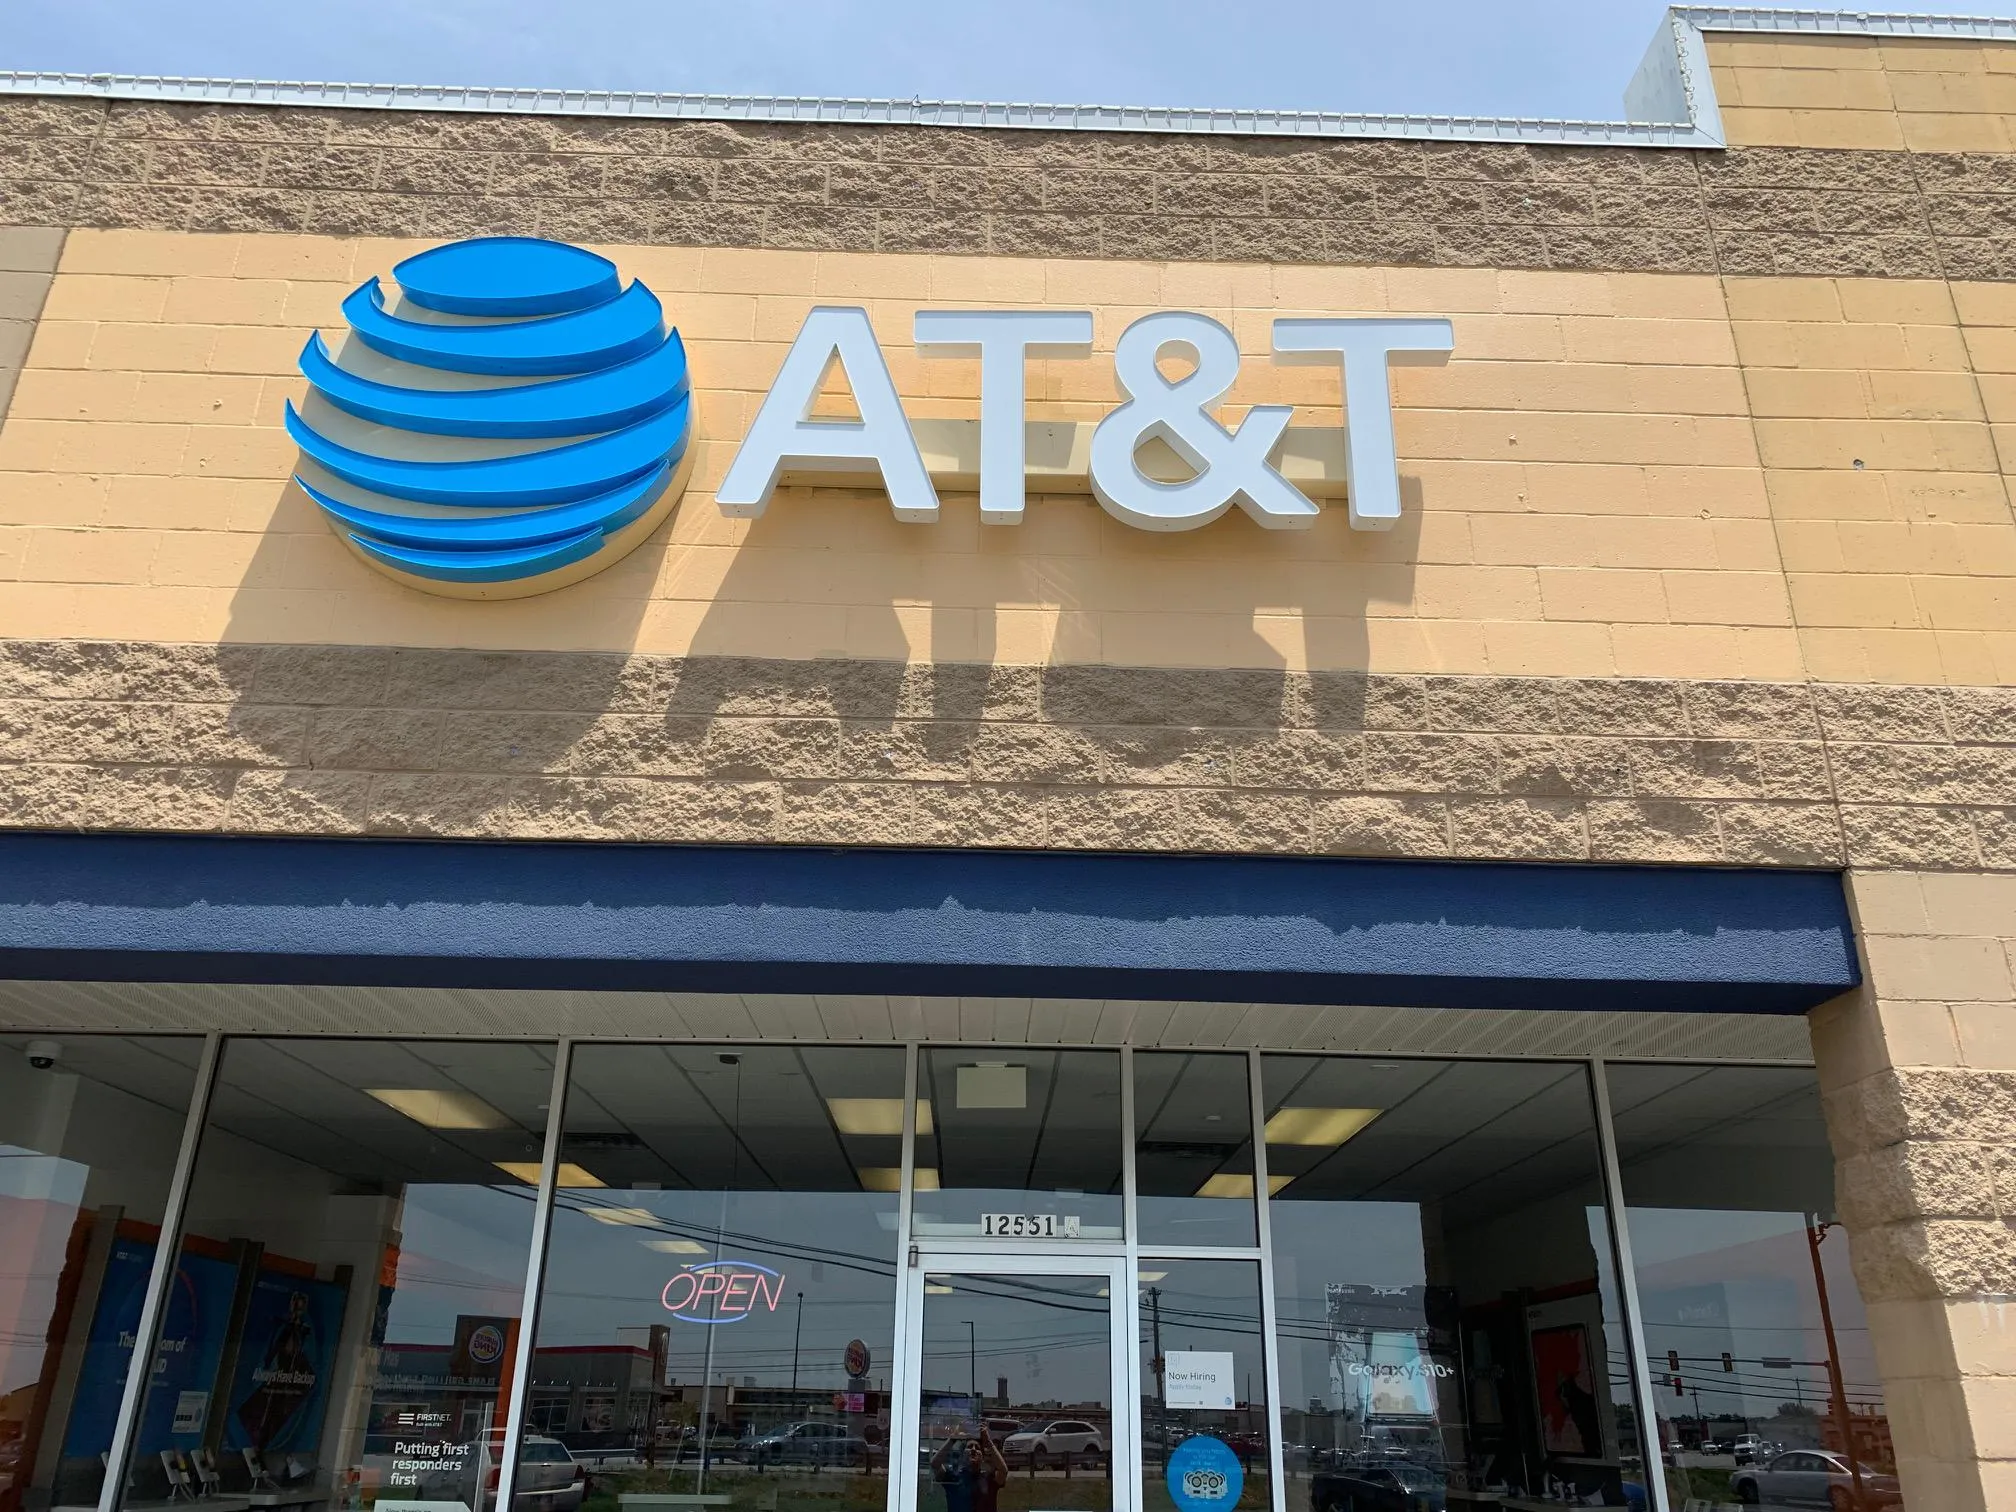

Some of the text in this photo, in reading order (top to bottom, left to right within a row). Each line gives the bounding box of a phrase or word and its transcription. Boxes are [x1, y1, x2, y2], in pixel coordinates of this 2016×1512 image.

[714, 306, 1455, 531] AT&T
[985, 1215, 1054, 1236] 12551
[661, 1273, 786, 1312] OPEN
[252, 1367, 277, 1385] Always
[293, 1370, 317, 1388] Backup
[1168, 1372, 1216, 1383] Now Hiring
[1348, 1363, 1417, 1380] Galaxy
[394, 1441, 470, 1458] Putting first
[392, 1458, 462, 1472] responders
[390, 1472, 418, 1486] first
